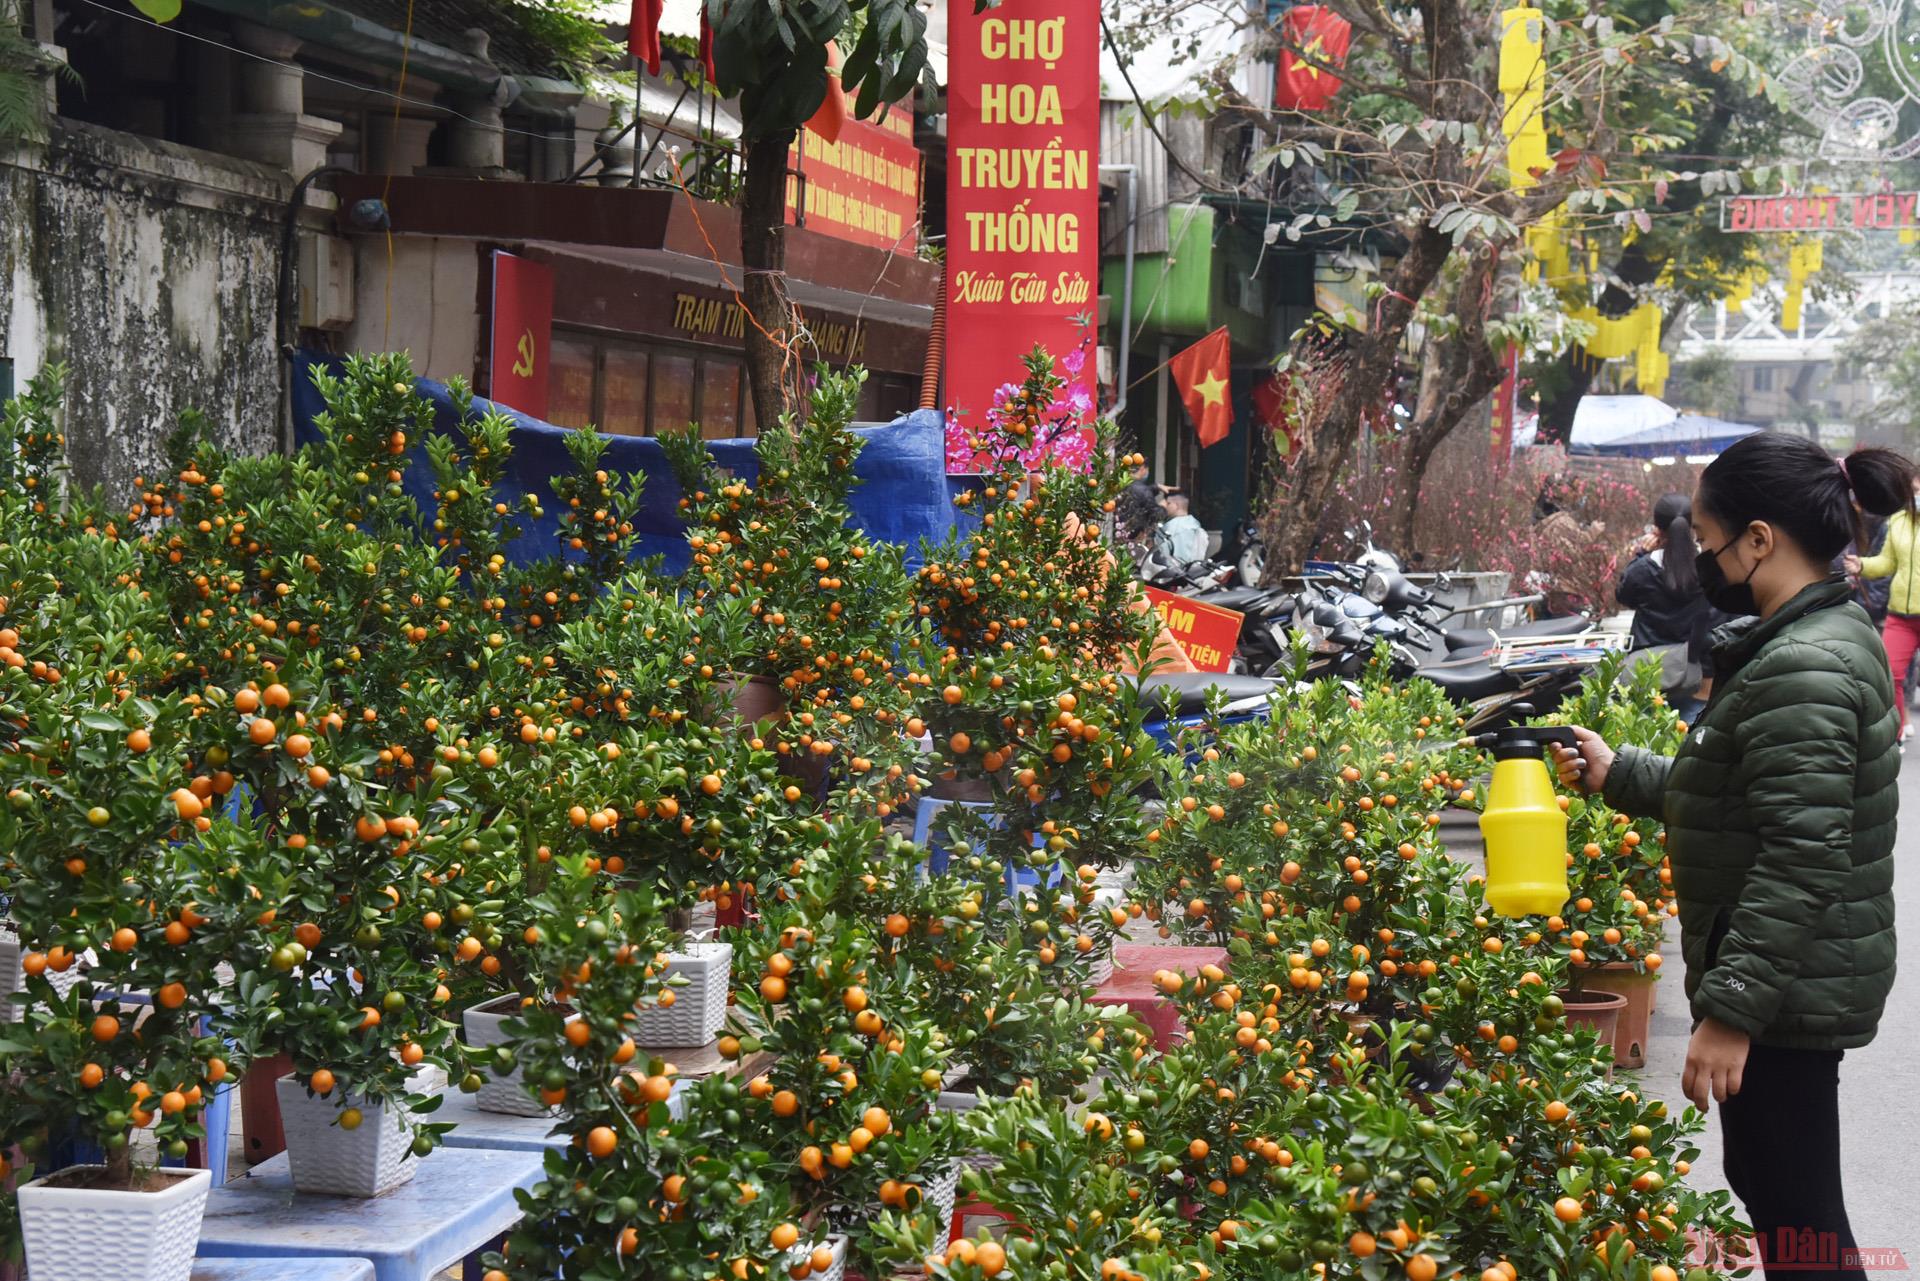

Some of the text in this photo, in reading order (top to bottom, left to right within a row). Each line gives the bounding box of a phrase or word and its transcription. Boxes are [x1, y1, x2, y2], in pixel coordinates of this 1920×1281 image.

[981, 15, 1066, 70] CHỢ
[981, 83, 1064, 125] HOA
[956, 136, 1088, 189] TRUYỀN
[965, 199, 1079, 253] THỐNG
[953, 271, 1091, 305] Xuân Tân Sửu
[674, 294, 721, 339] TRẠM
[1157, 600, 1196, 634] ẤM
[1189, 642, 1221, 666] TIỆN
